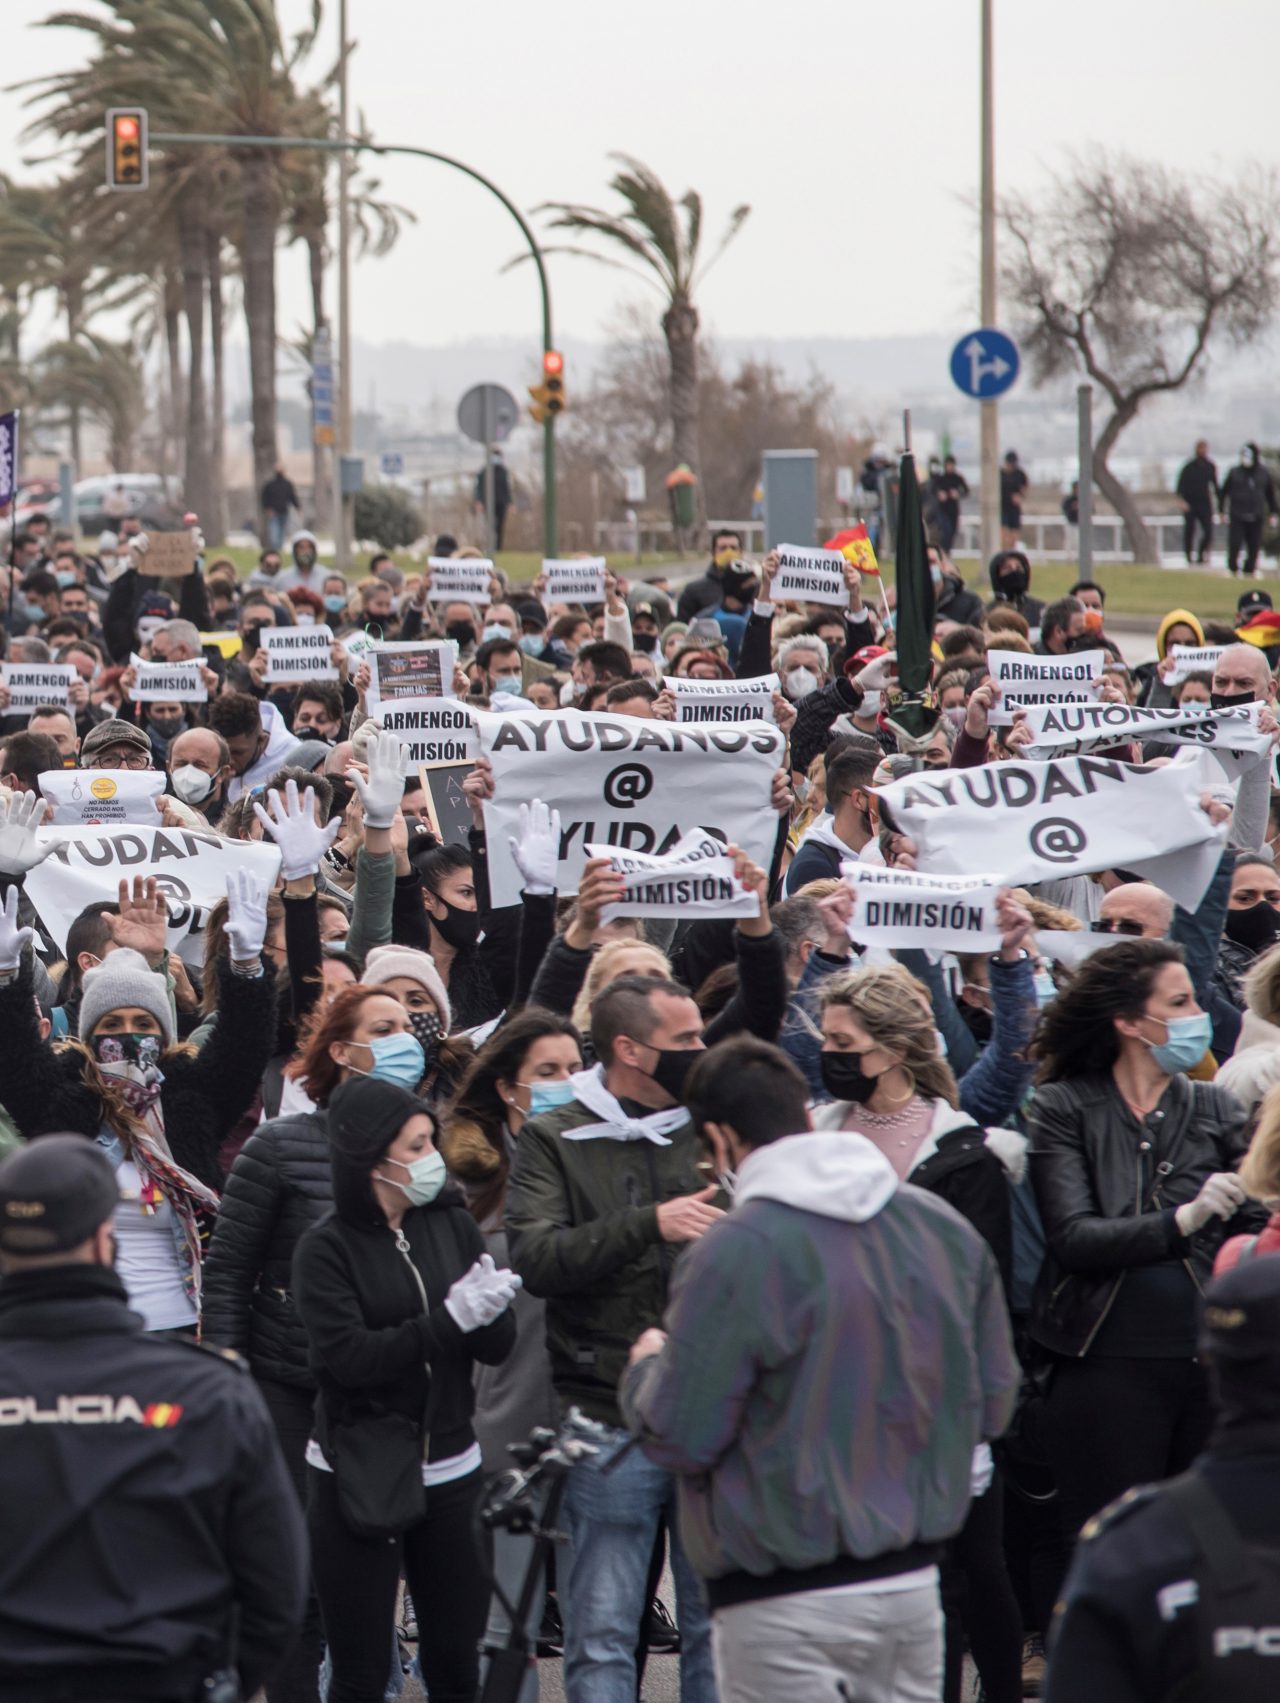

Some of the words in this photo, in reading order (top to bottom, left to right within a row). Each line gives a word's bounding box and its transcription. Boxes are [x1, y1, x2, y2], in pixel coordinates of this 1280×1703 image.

[780, 554, 843, 573] ARMENGOL
[269, 634, 330, 648] ARMENGOL
[272, 656, 328, 671] DIMISIÓN
[1000, 663, 1093, 680] ARMENGOL
[9, 673, 71, 687] ARMENGOL
[141, 676, 196, 690] DIMISIÓN
[383, 711, 473, 730] ARMENGOL
[682, 703, 764, 722] DIMISIÓN
[491, 719, 778, 754] AYUDANOS
[604, 762, 653, 809] @
[1030, 816, 1087, 863] @
[621, 874, 734, 905] DIMISIÓN
[859, 870, 993, 890] ARMENGOL
[866, 901, 984, 931] DIMISIÓN
